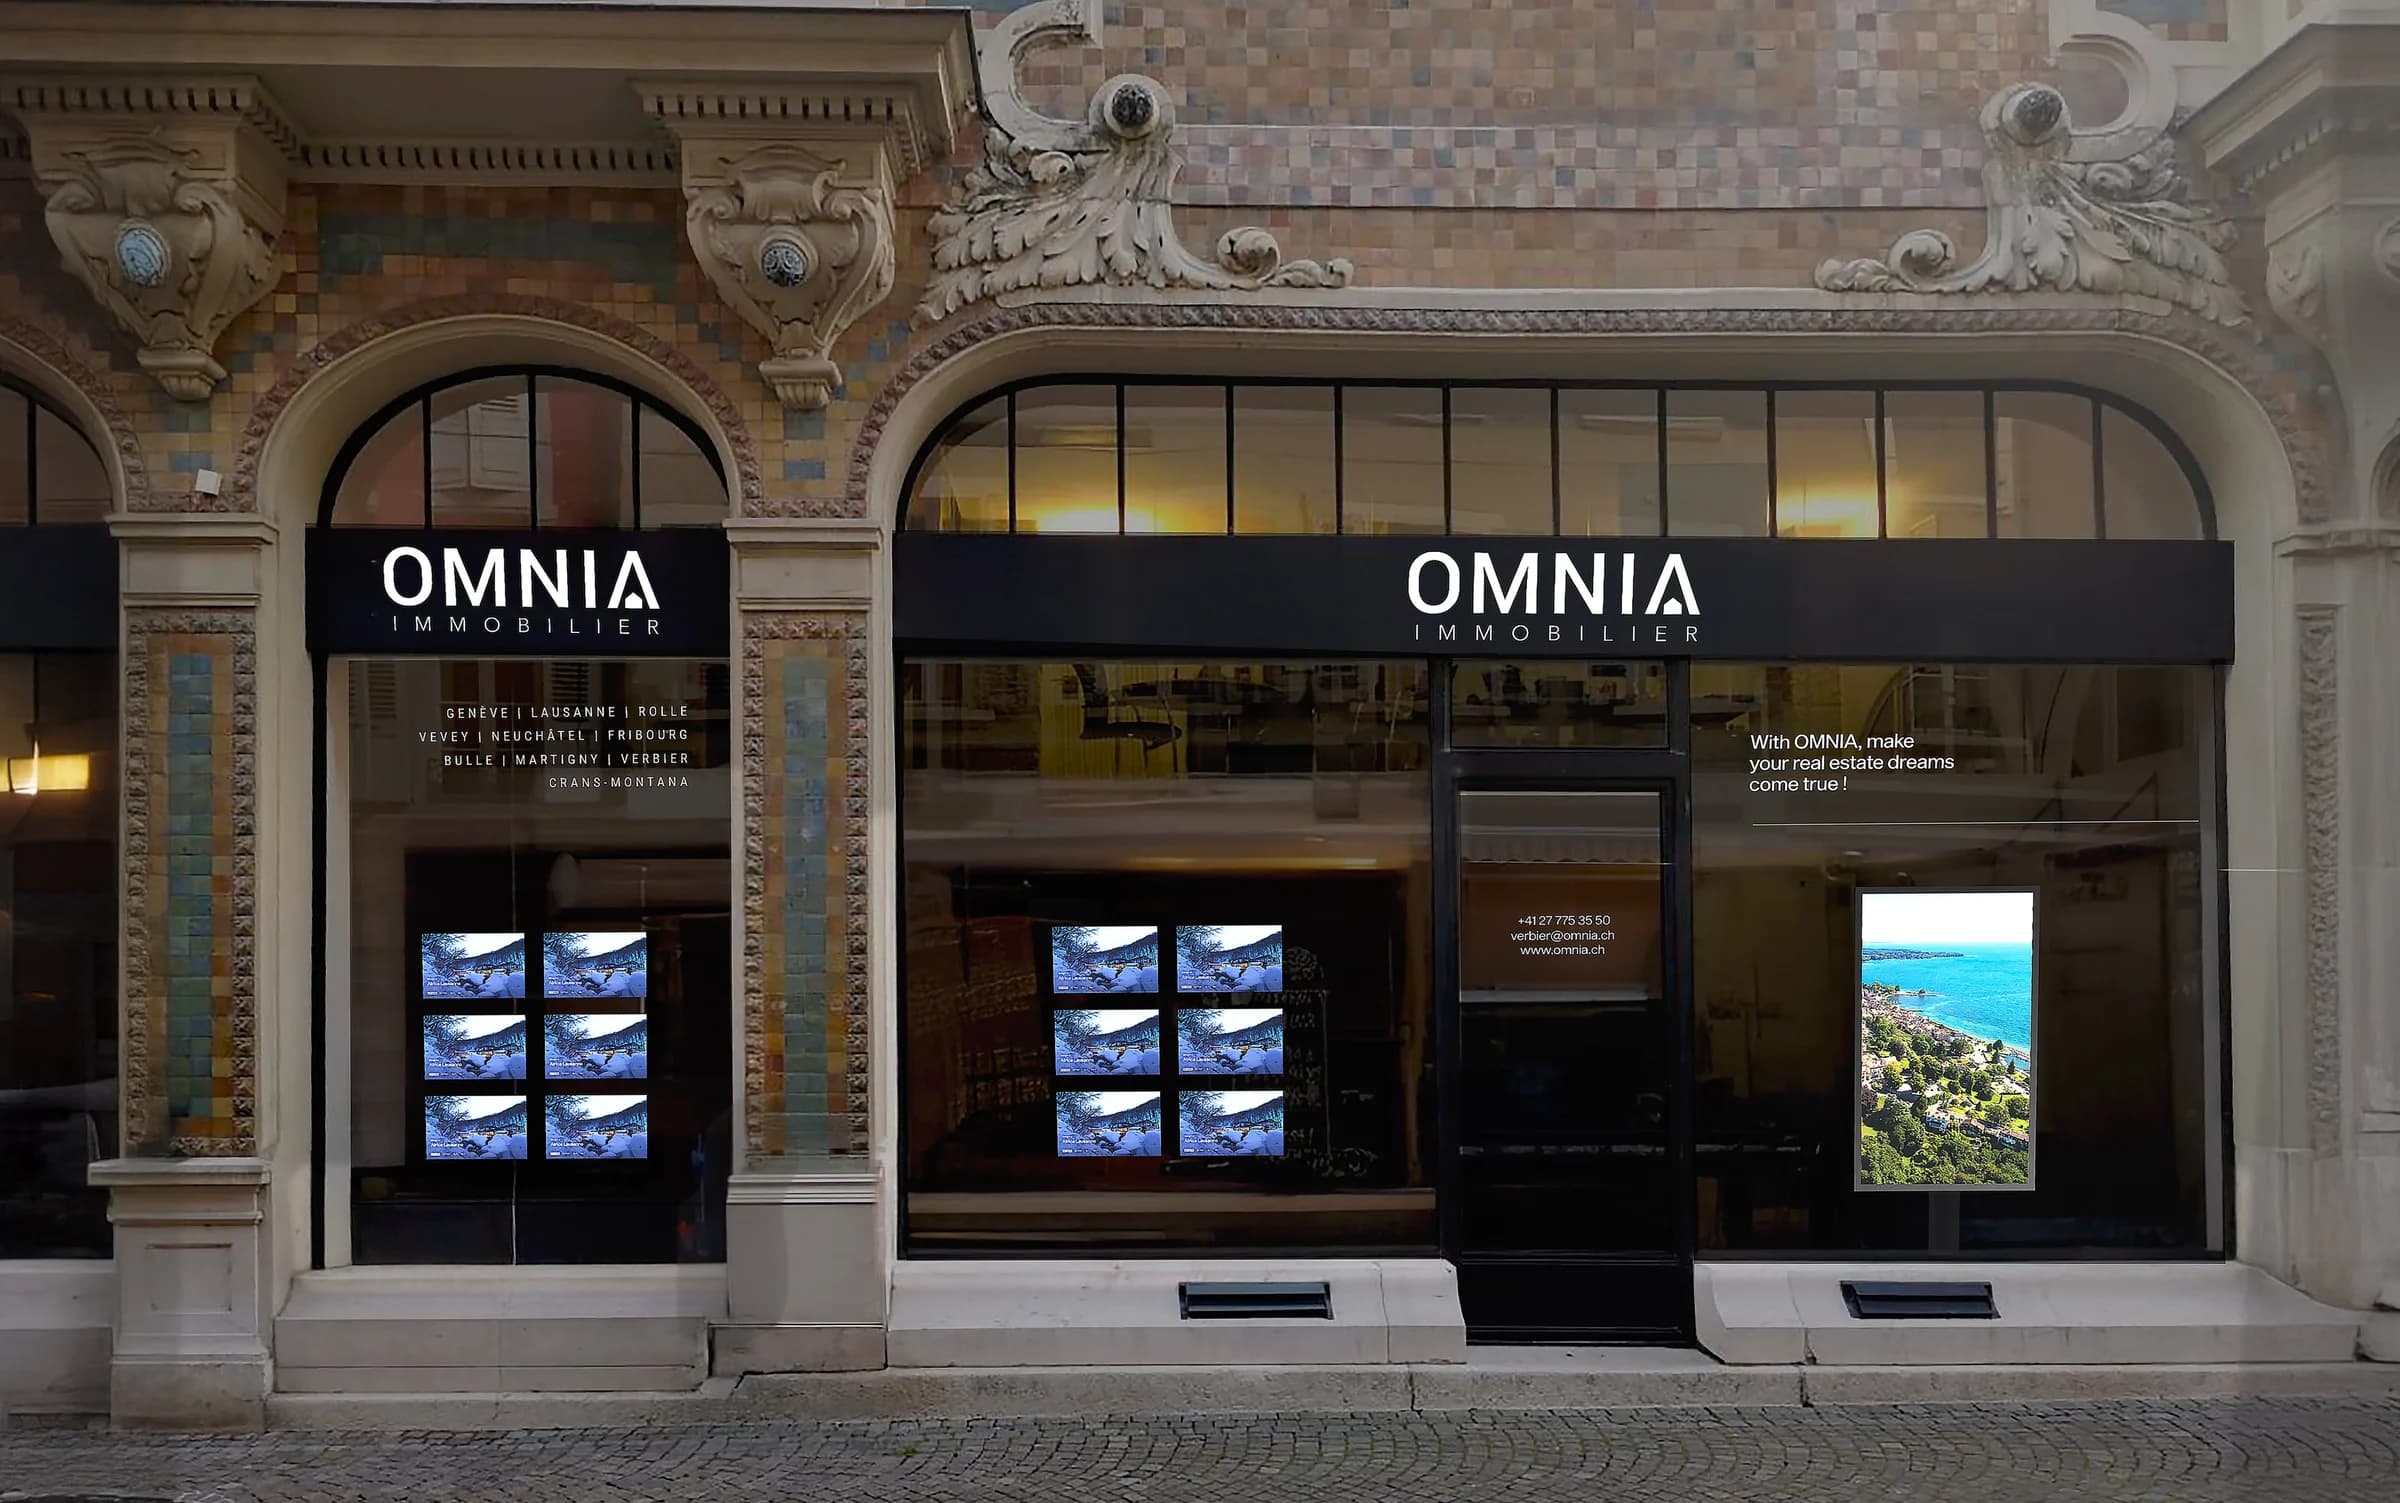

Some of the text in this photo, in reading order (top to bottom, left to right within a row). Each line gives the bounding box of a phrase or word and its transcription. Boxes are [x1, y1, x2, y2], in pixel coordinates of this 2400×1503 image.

[383, 546, 660, 610] OMNIA
[1408, 551, 1701, 616] OMNIA
[393, 615, 660, 635] IMMOBILIER
[1415, 624, 1699, 642] IMMOBILIER
[446, 705, 509, 719] GENÈVE
[531, 706, 616, 718] LAUSANNE
[638, 705, 688, 717] ROLLE
[418, 731, 469, 743] VEVEY
[491, 728, 585, 742] NEUCHÂTEL
[607, 729, 688, 741] FRIBOURG
[1750, 733, 1915, 752] With OMNIA, make
[444, 754, 493, 766] BULLE
[515, 753, 598, 766] MARTIGNY
[620, 752, 688, 765] VERBIER
[1749, 754, 1955, 775] your real estate dreams
[549, 776, 688, 788] CRANS-MONTANA
[1749, 779, 1799, 792] come
[1802, 777, 1839, 792] true
[1554, 915, 1576, 926] 775
[1577, 915, 1593, 926] 35
[1594, 914, 1611, 926] 50
[1510, 929, 1616, 943] verbier@omnia.ch
[1519, 944, 1606, 956] www.omnia.ch
